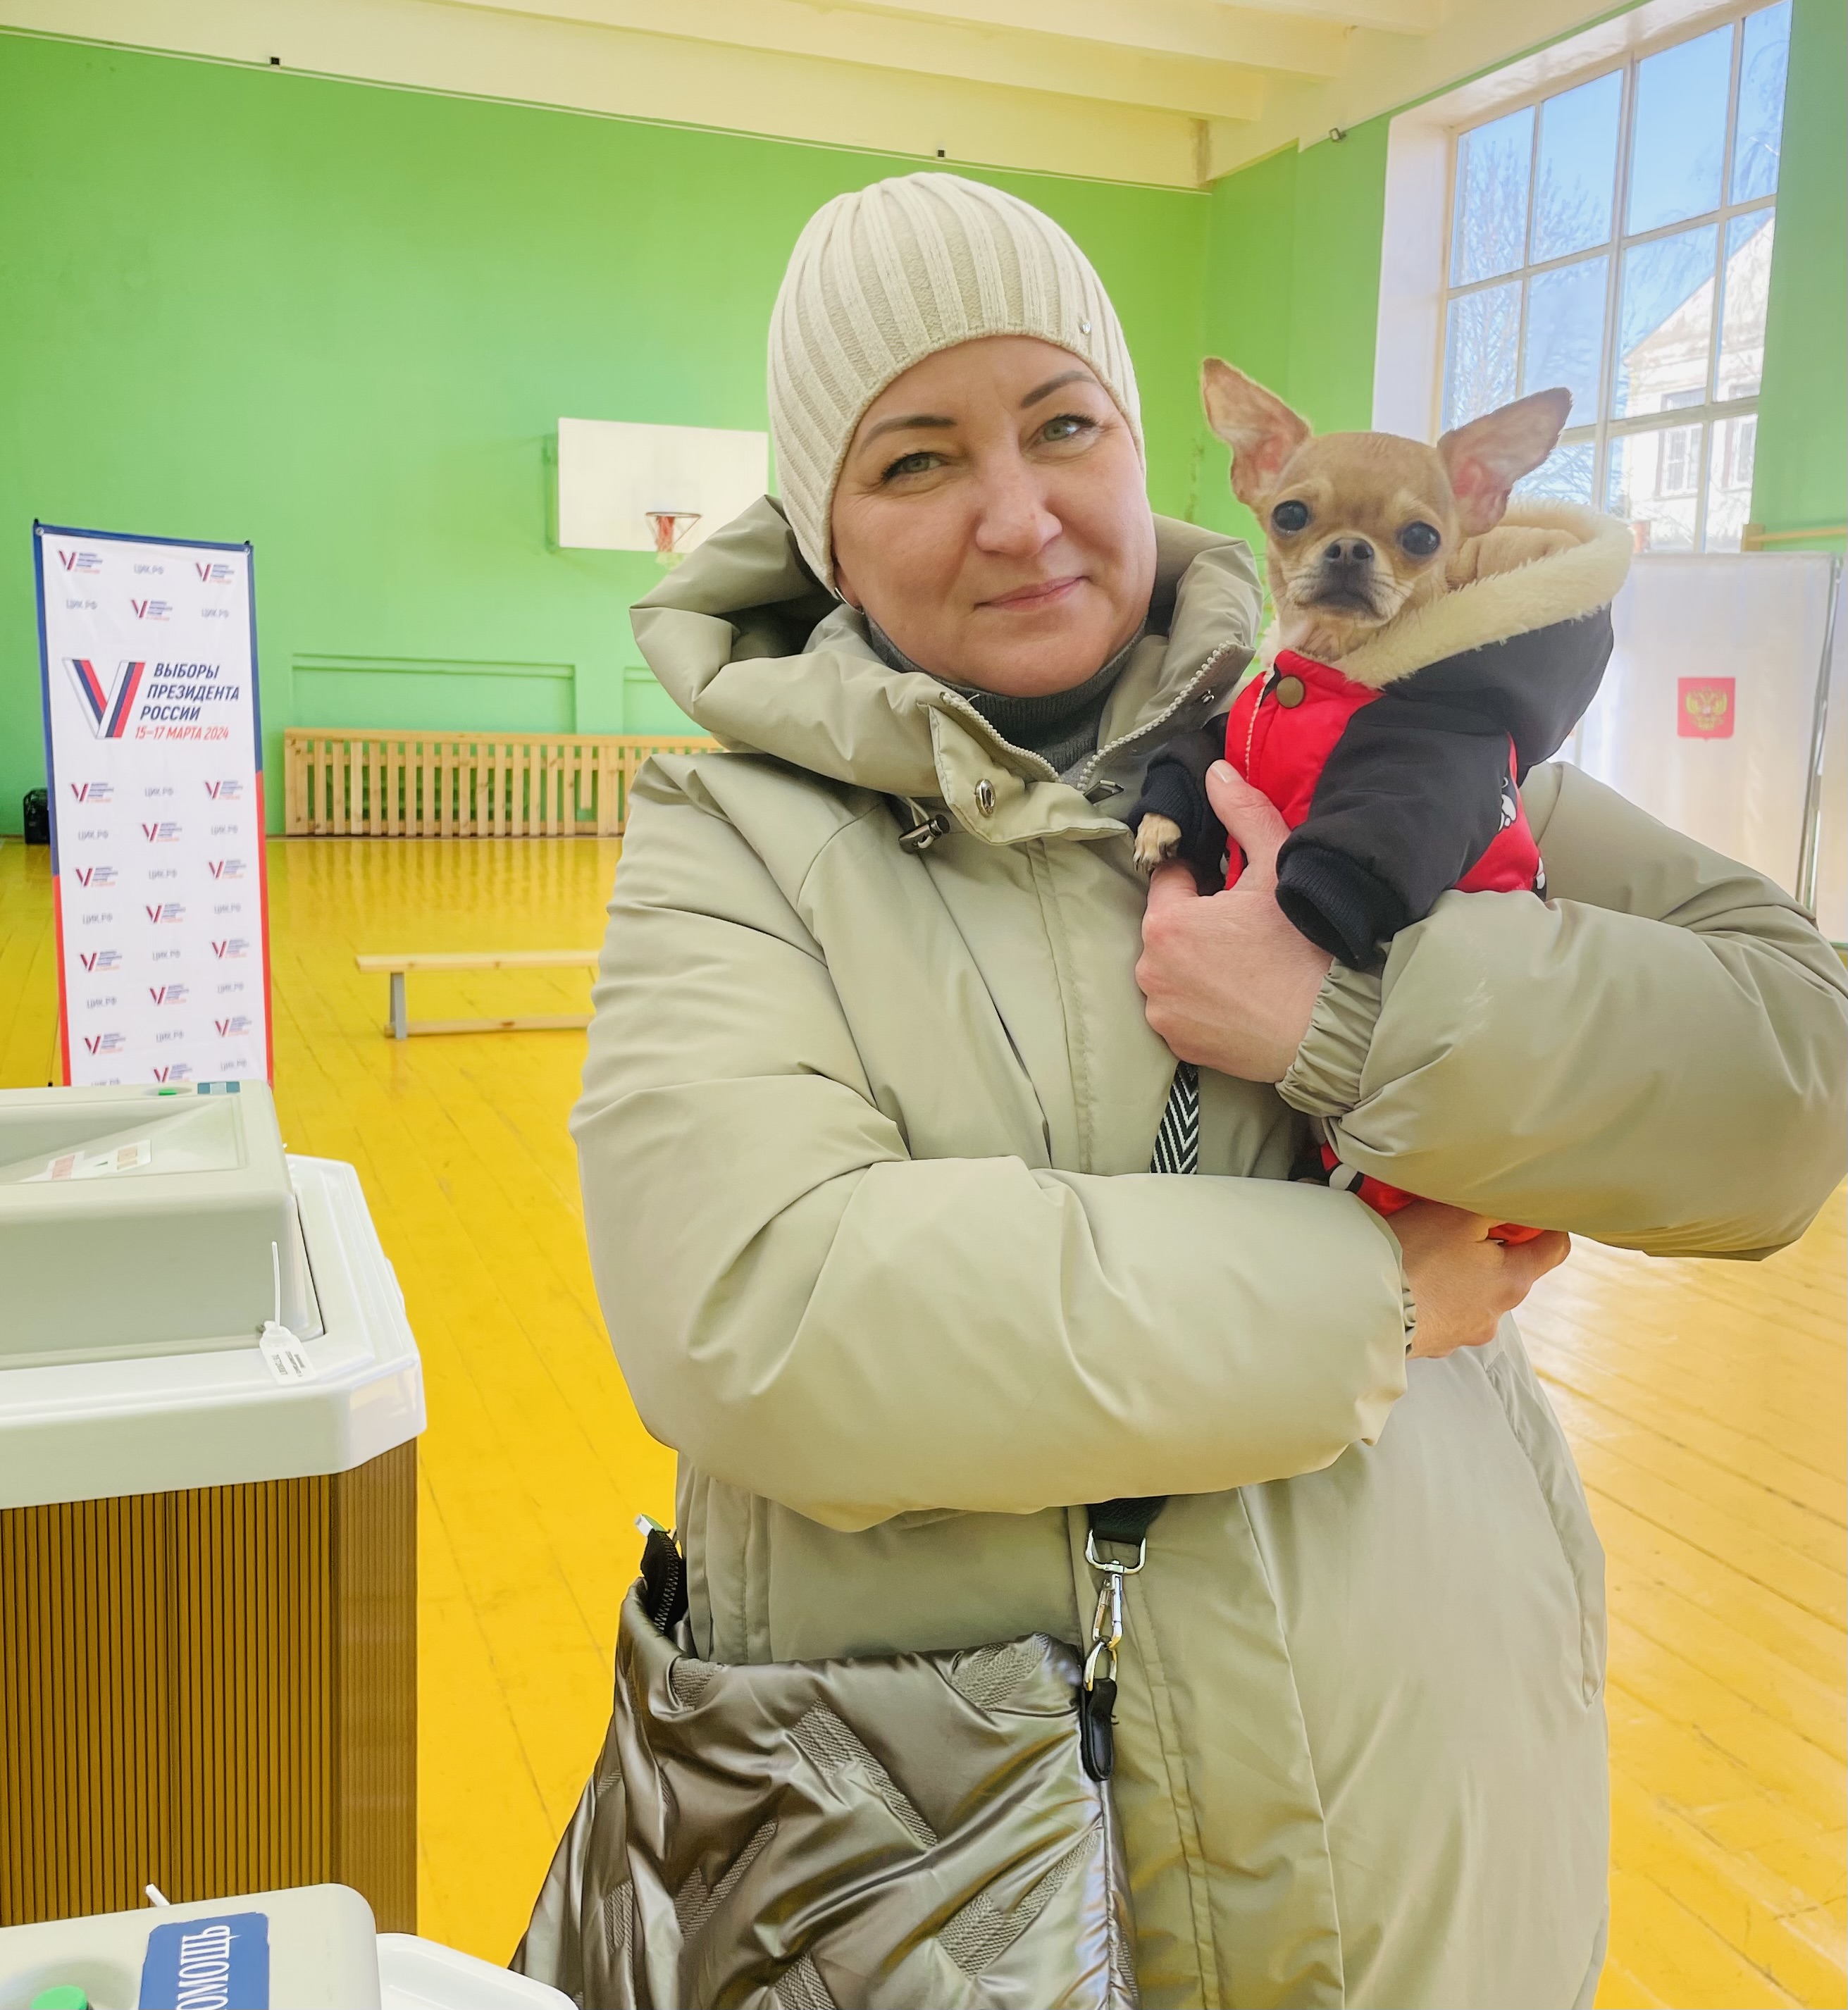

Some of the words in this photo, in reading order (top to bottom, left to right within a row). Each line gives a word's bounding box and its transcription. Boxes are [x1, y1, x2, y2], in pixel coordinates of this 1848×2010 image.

[154, 662, 220, 680] ВЫБОРЫ
[147, 683, 240, 702] ПРЕЗИДЕНТА
[139, 705, 201, 721] РОССИИ
[166, 725, 203, 740] МАРТА
[204, 726, 230, 740] 2024
[176, 1925, 242, 2010] ОМОЩЬ
